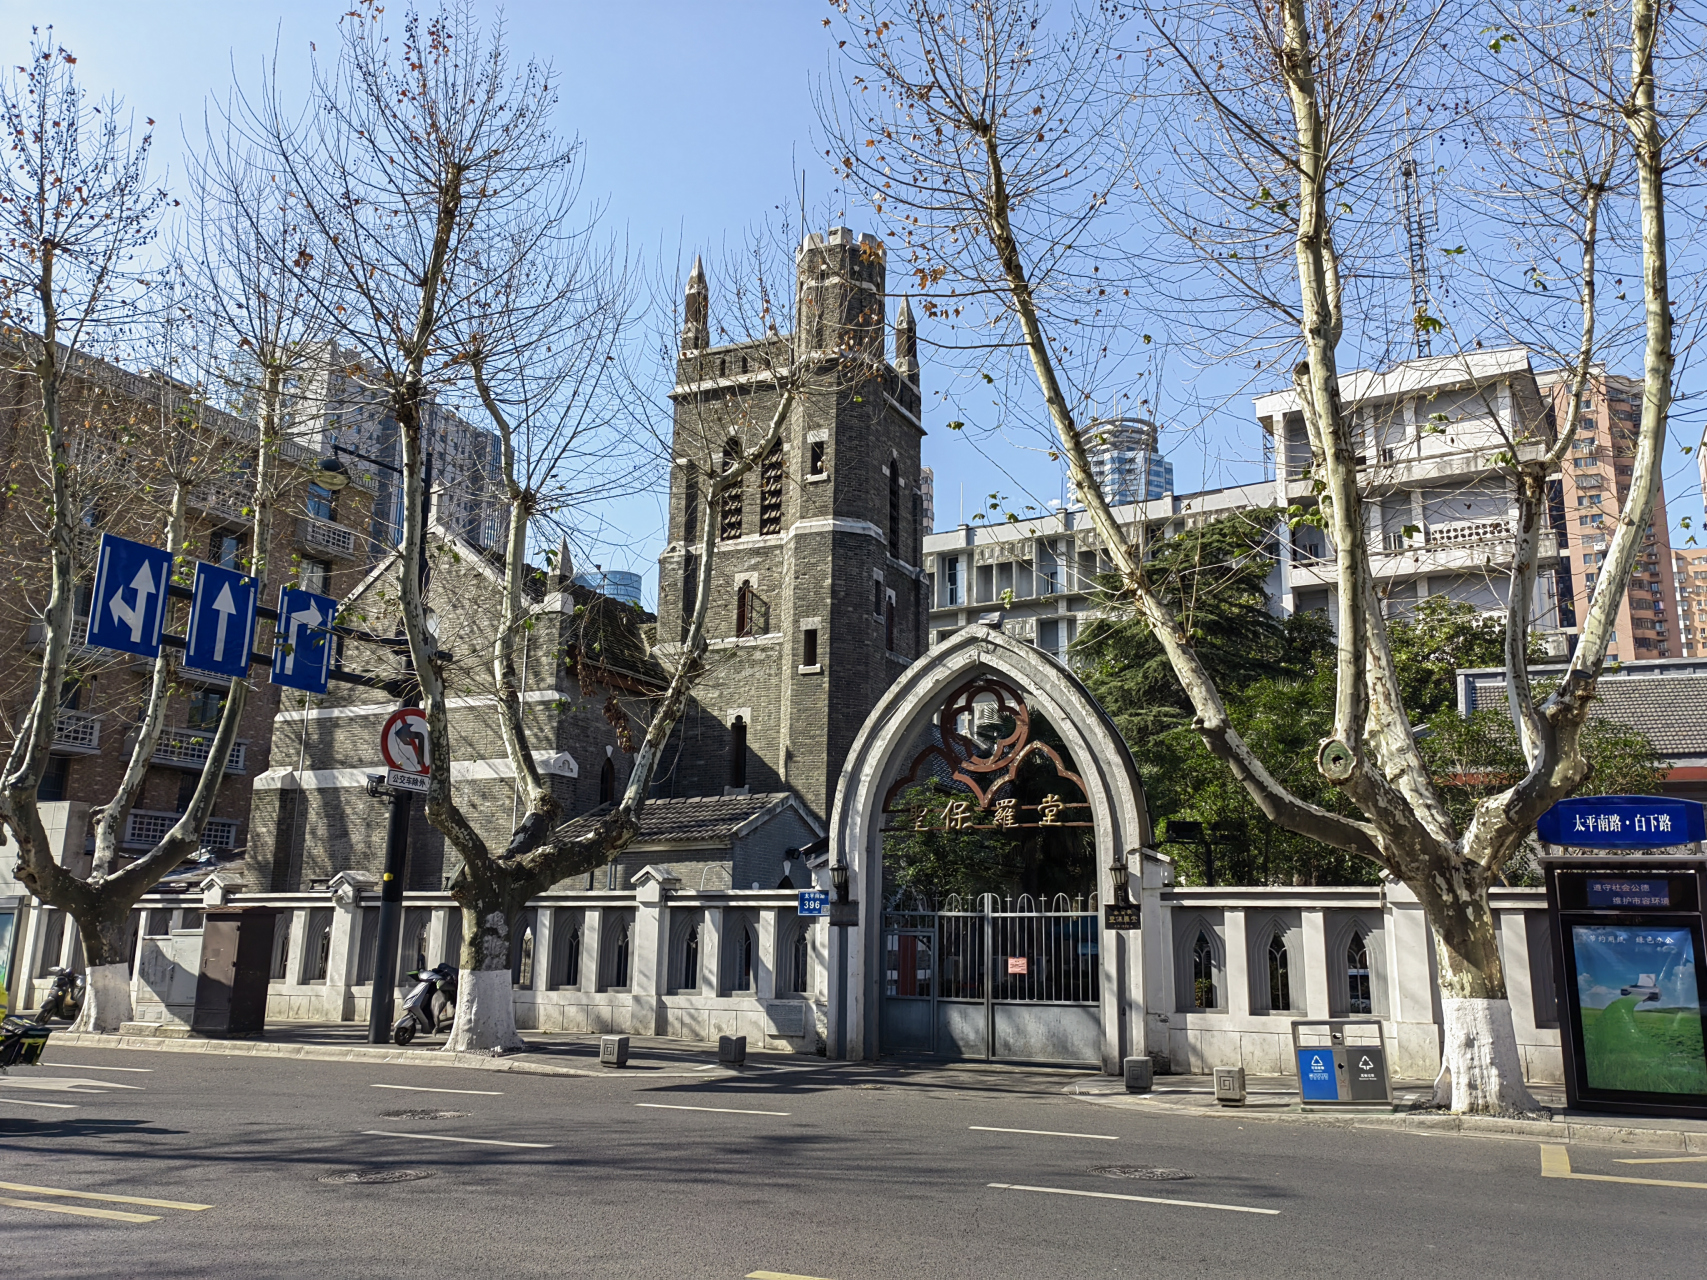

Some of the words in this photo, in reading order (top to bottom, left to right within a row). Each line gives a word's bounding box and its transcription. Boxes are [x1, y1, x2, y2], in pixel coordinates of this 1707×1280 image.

[392, 774, 426, 788] 公交车除外
[907, 793, 1066, 832] 聖保羅堂
[1572, 813, 1672, 833] 太平南路·白下路
[1592, 883, 1650, 893] 遵守社会公德
[803, 900, 821, 909] 396
[1612, 896, 1670, 906] 维护市容环境
